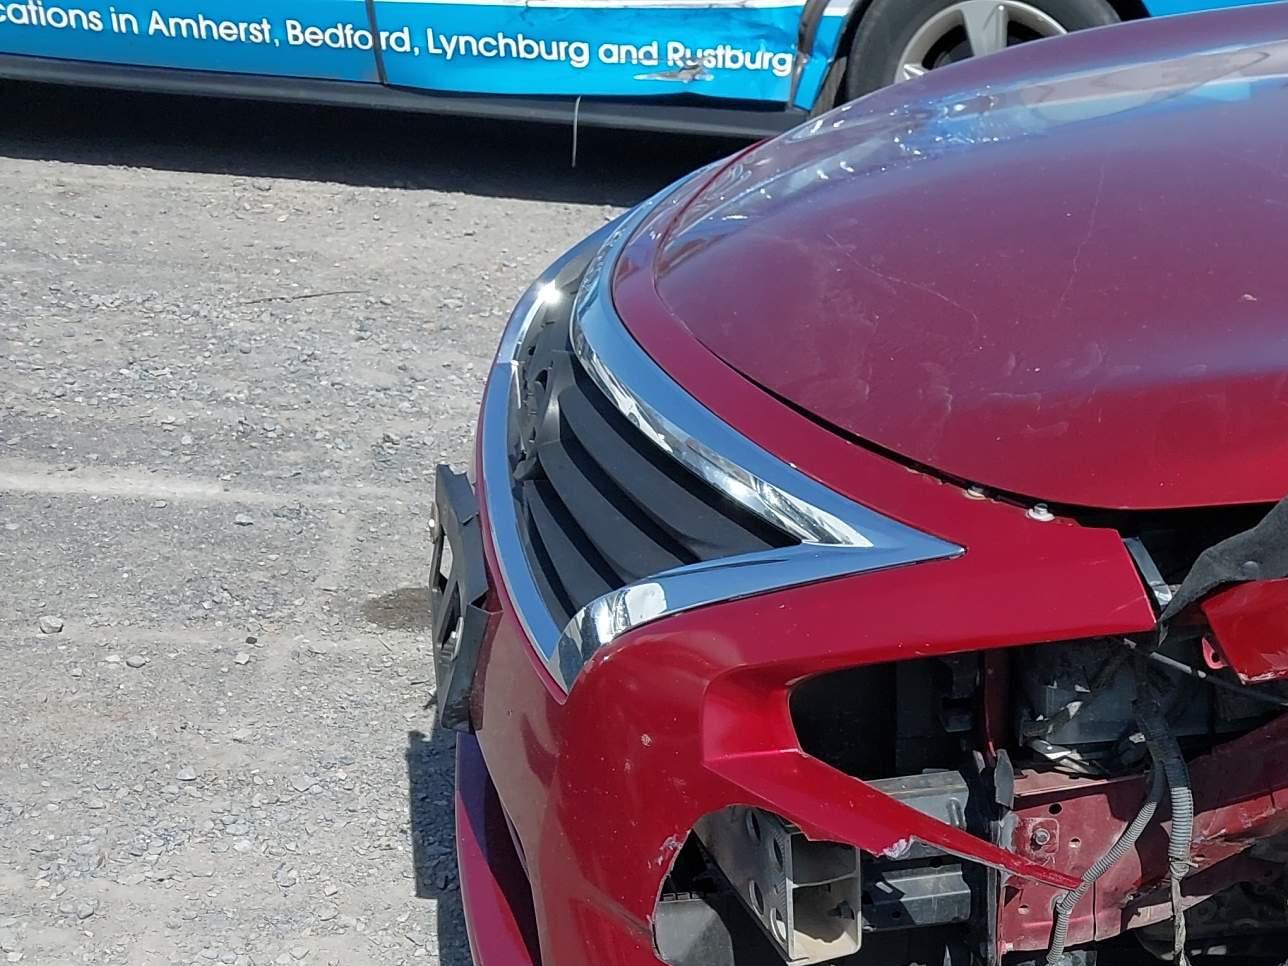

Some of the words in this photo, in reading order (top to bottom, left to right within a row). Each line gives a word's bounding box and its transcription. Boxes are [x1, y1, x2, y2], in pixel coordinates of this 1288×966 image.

[110, 6, 139, 35] in
[149, 10, 280, 47] Amherst,
[286, 19, 419, 57] Bedford,
[427, 28, 590, 68] Lynchburg
[598, 40, 659, 66] and
[666, 40, 793, 77] Rustburg
